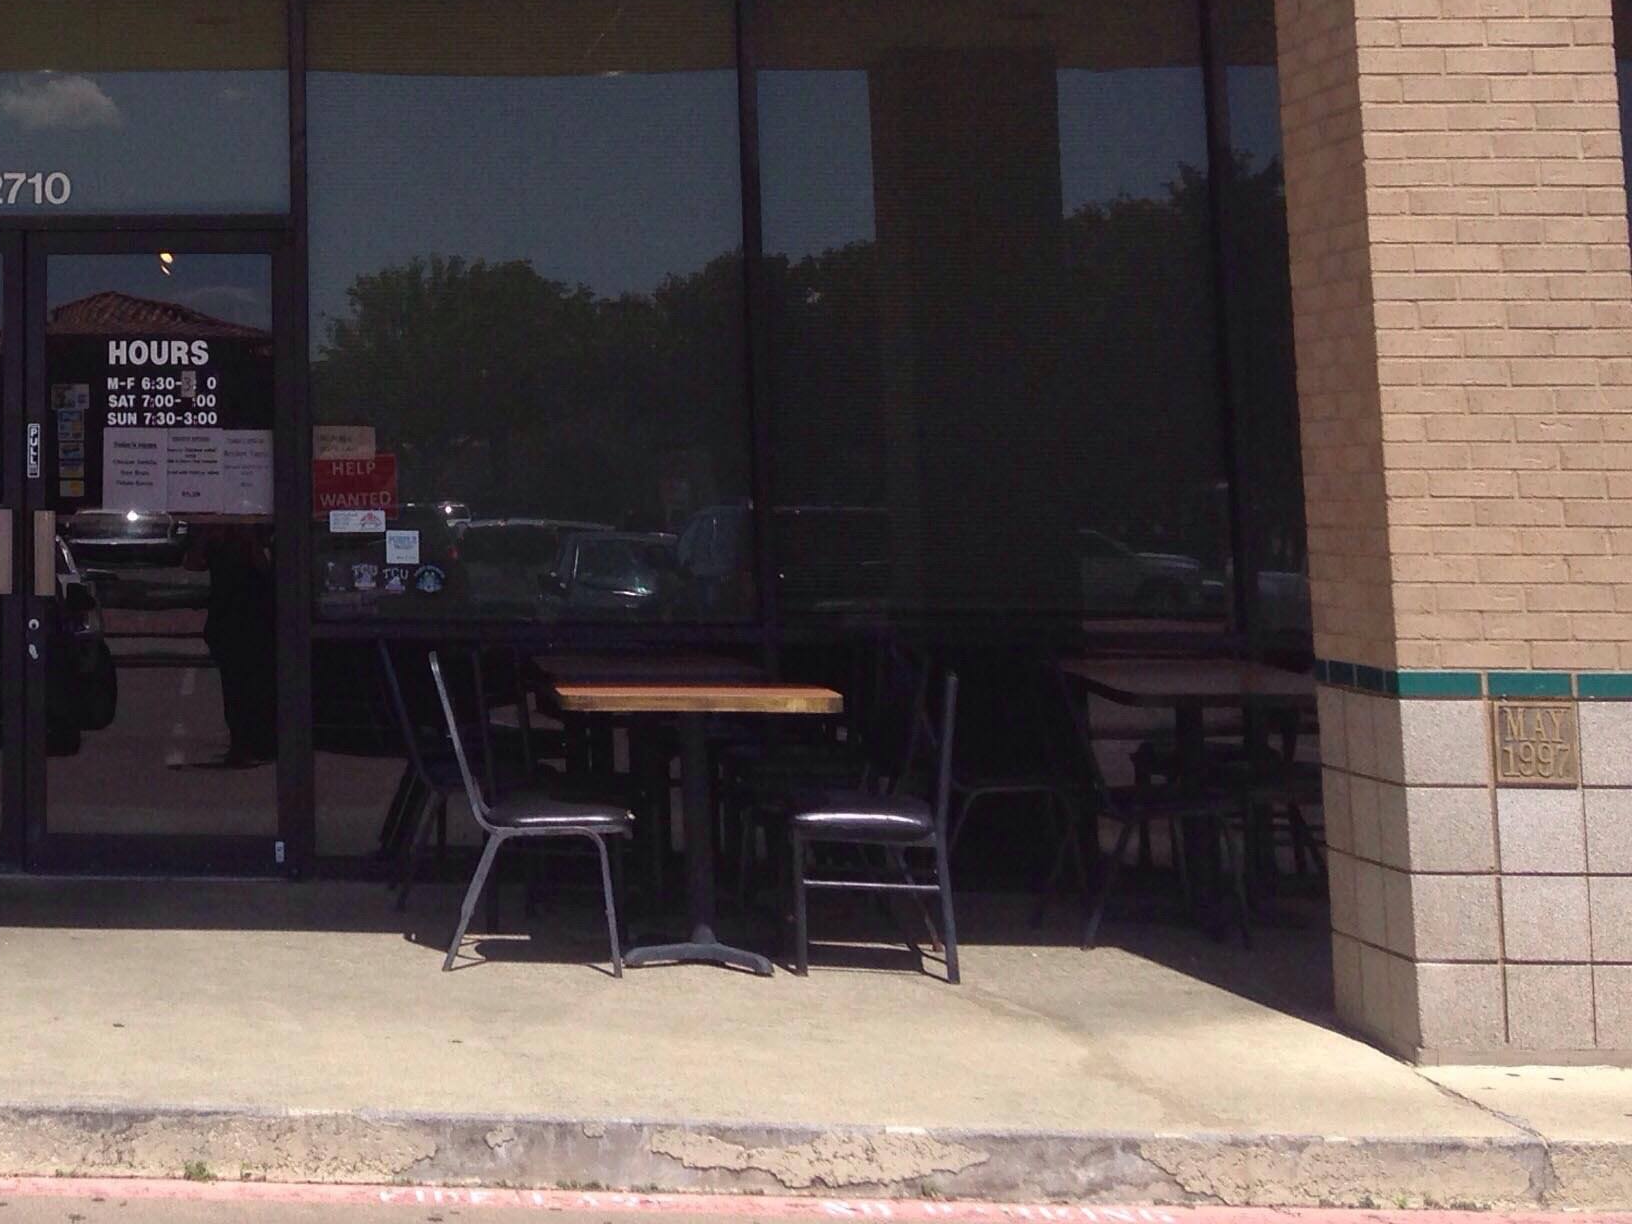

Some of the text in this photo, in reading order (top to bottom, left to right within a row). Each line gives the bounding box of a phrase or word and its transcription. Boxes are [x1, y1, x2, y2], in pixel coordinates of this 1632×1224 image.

[108, 340, 210, 366] HOURS
[107, 377, 135, 390] M-F
[108, 395, 135, 408] SAT
[107, 412, 137, 425] SUN
[29, 427, 39, 465] PULL
[332, 461, 376, 476] HELP
[319, 490, 392, 508] WANTED
[1503, 707, 1571, 743] MAY
[1502, 741, 1569, 779] 1997
